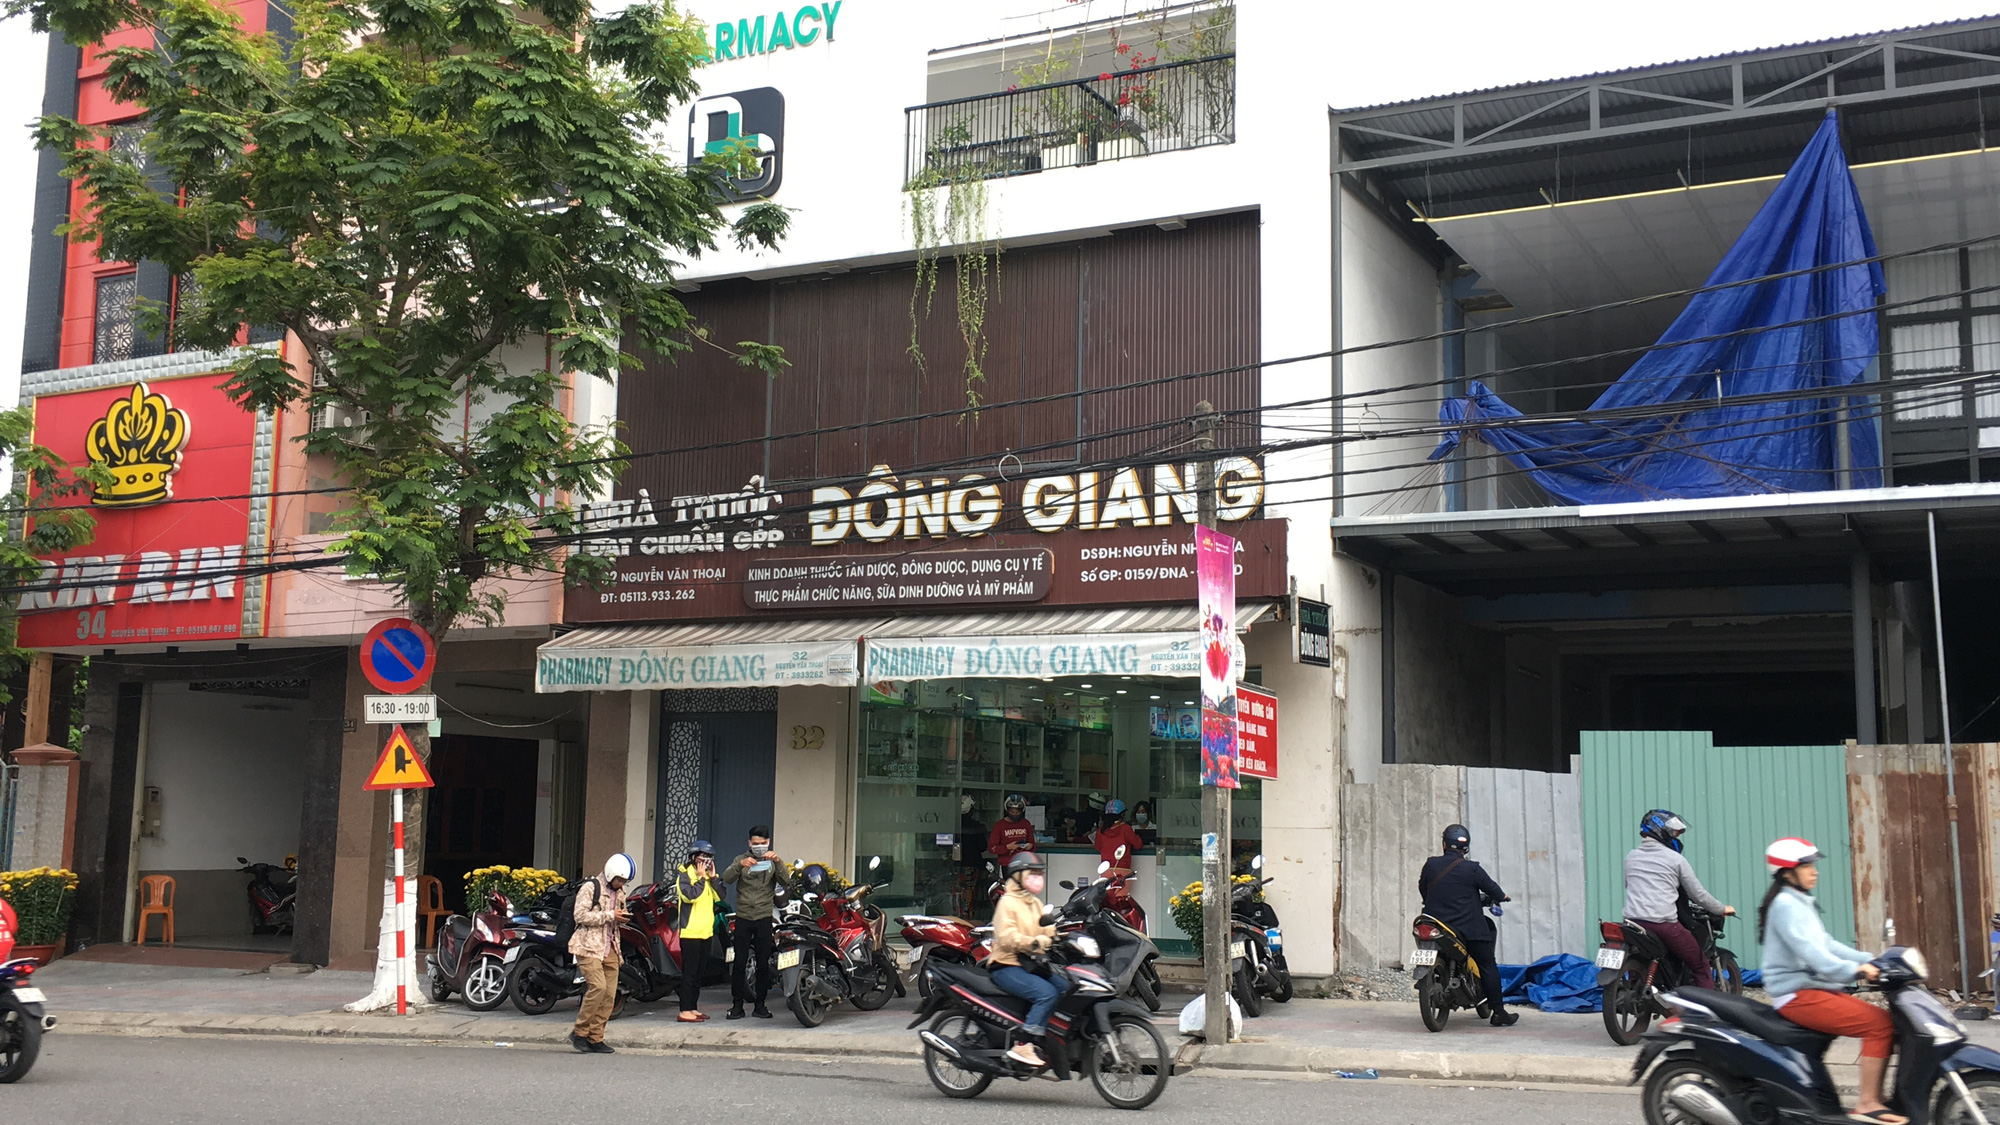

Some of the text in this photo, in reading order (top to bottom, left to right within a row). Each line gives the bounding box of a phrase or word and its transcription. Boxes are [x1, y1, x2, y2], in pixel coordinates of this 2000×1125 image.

[807, 457, 1264, 546] ĐÔNG GIANG
[1123, 539, 1177, 558] NGUYỄN
[621, 566, 664, 582] NGUYỄN
[667, 567, 690, 581] VĂN
[692, 567, 726, 582] THOẠI
[748, 568, 771, 581] KINH
[773, 566, 808, 580] DOANH
[866, 562, 899, 580] DƯỢC,
[902, 559, 933, 575] ĐÔNG
[935, 558, 969, 577] DƯỢC,
[971, 558, 1001, 576] DỤNG
[1004, 558, 1020, 575] CỤ
[1022, 557, 1030, 571] Y
[1032, 551, 1046, 571] TẾ
[1080, 567, 1098, 582] Số
[1099, 569, 1121, 582] GP:
[1124, 567, 1188, 580] 0159/ĐNA
[601, 589, 695, 604] ĐT: 05113.933.262
[754, 575, 1034, 606] THỰC PHẨM CHỨC NĂNG, SỮA DINH DƯỠNG VÀ MỸ PHẨM
[76, 611, 106, 640] 34
[1170, 641, 1189, 650] 32
[792, 651, 808, 660] 32
[869, 646, 955, 676] PHARMACY
[964, 638, 1041, 676] ĐÔNG
[1049, 643, 1139, 674] GIANG
[540, 650, 766, 685] PHARMACY ĐÔNG GIANG
[791, 671, 824, 679] 3933262
[1150, 663, 1162, 671] ĐT
[371, 702, 395, 714] 16:30
[404, 702, 430, 714] 19:00
